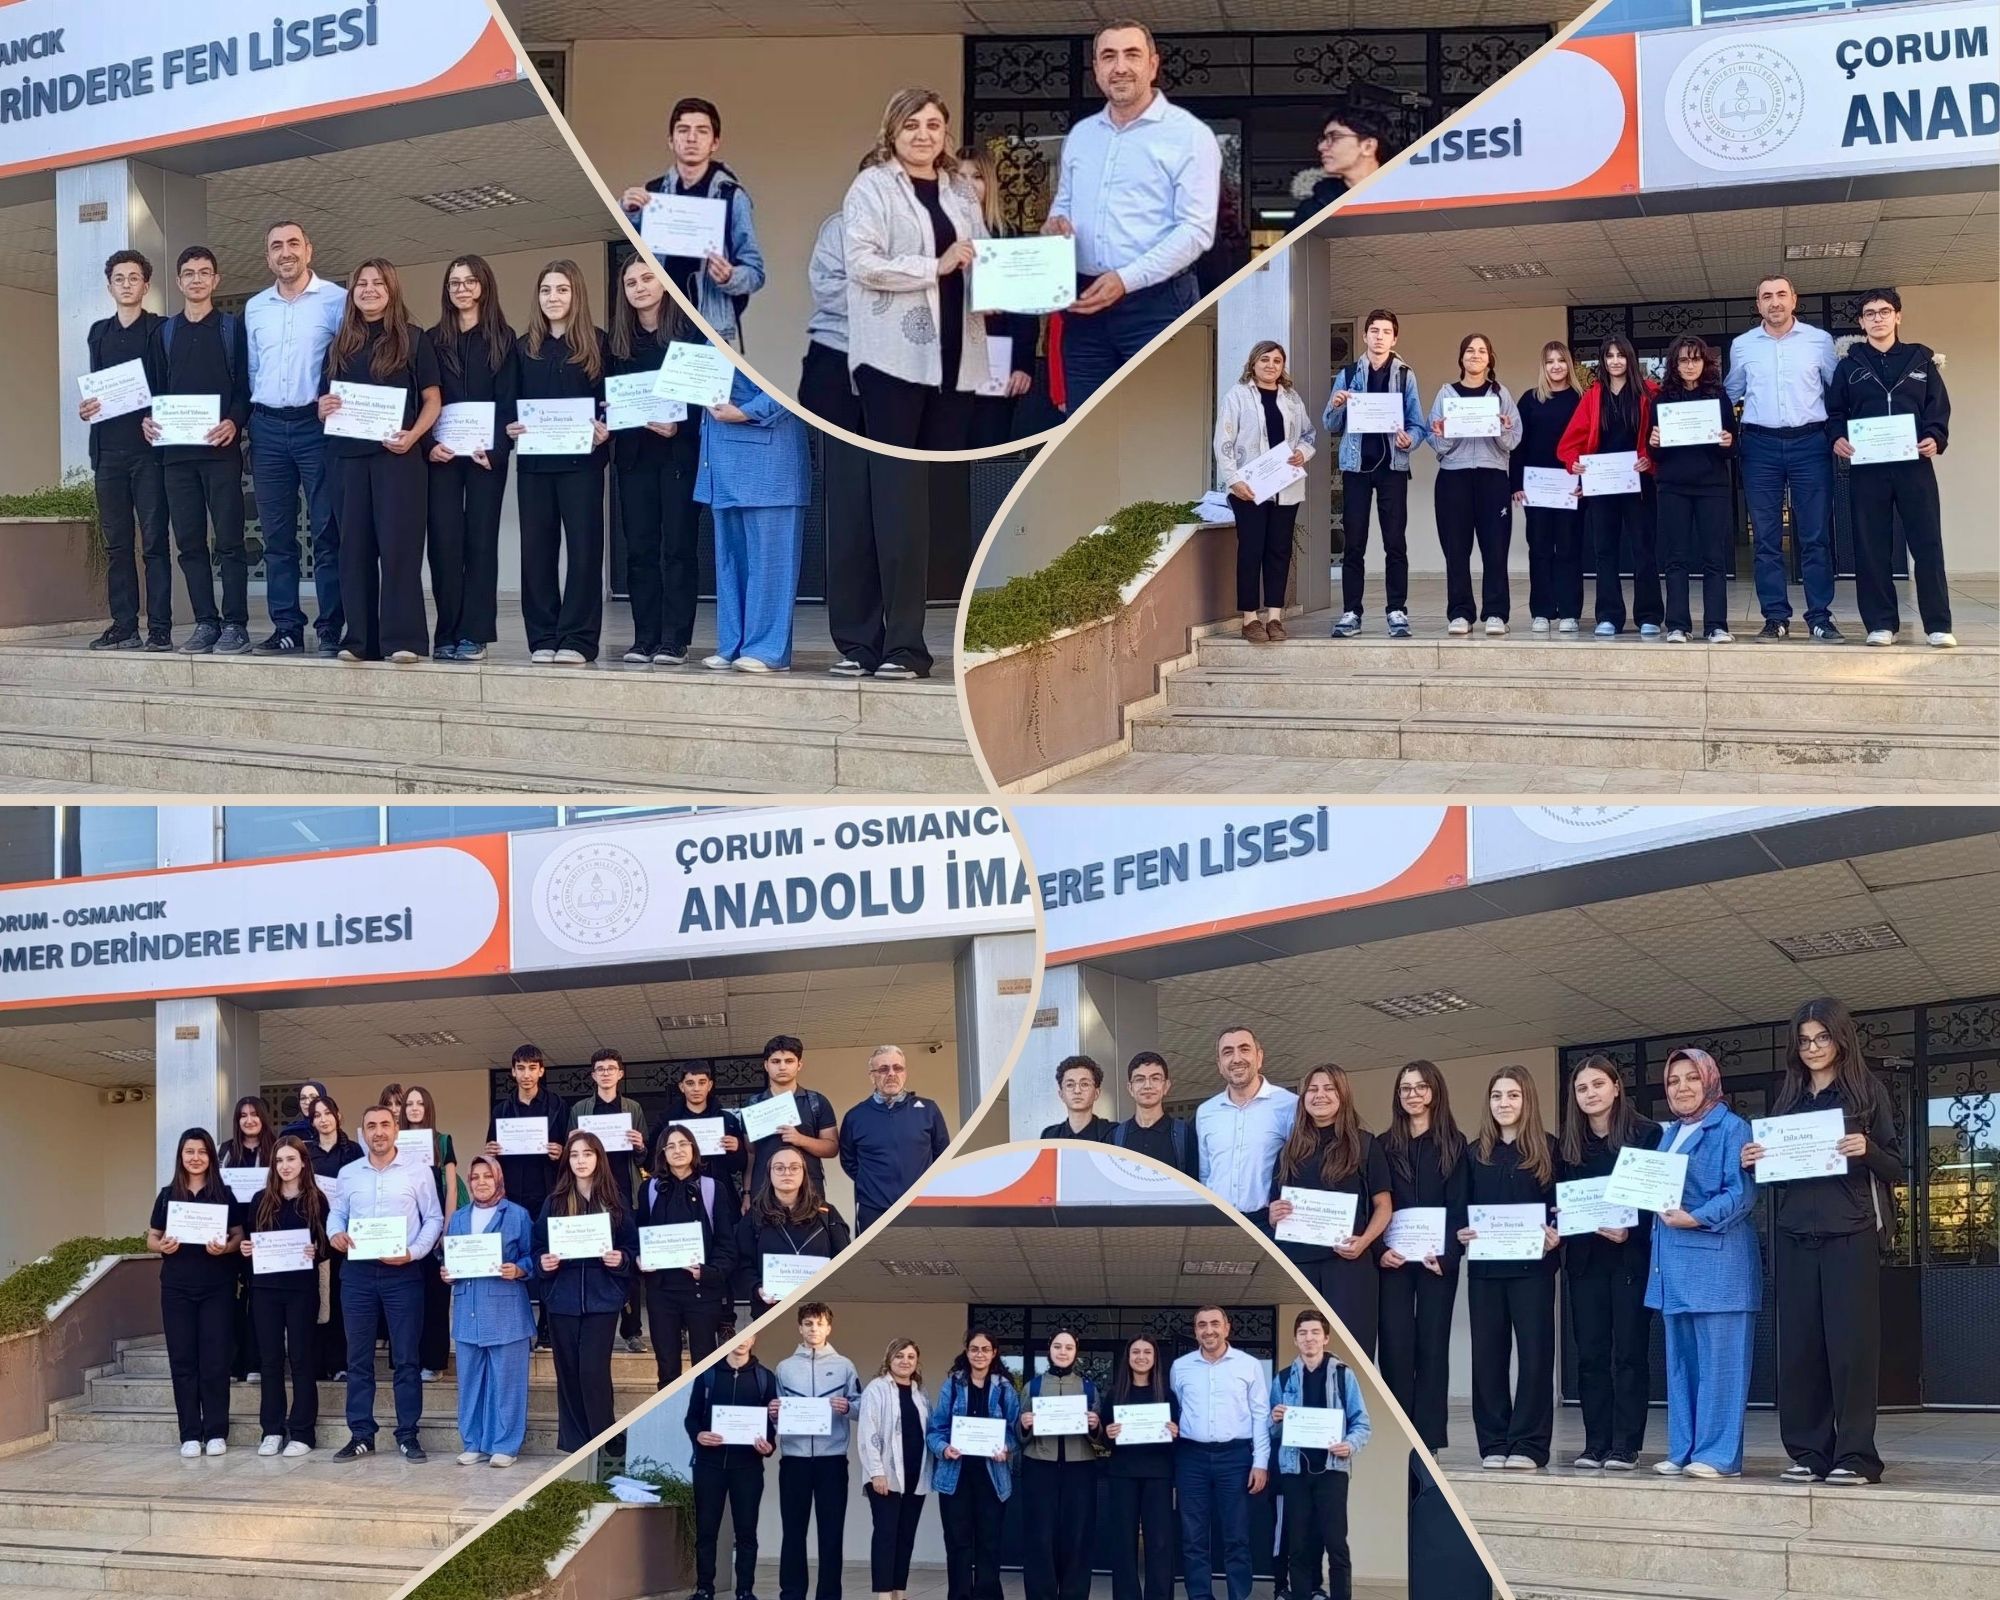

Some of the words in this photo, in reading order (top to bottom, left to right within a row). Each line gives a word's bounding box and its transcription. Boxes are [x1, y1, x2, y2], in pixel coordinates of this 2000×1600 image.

[0, 57, 153, 124] RİNDERE
[162, 37, 239, 90] FEN
[249, 0, 378, 72] LİSESİ
[1836, 26, 1988, 80] ÇORUM
[1841, 82, 2000, 148] ANAD
[675, 827, 803, 874] ÇORUM
[1114, 842, 1188, 896] FEN
[1200, 806, 1328, 877] LİSESİ
[63, 900, 167, 928] OSMANCIK
[678, 865, 926, 934] ANADOLU
[0, 943, 64, 974] MER
[71, 926, 241, 968] DERİNDERE
[248, 923, 308, 953] FEN
[317, 907, 414, 948] LİSESİ
